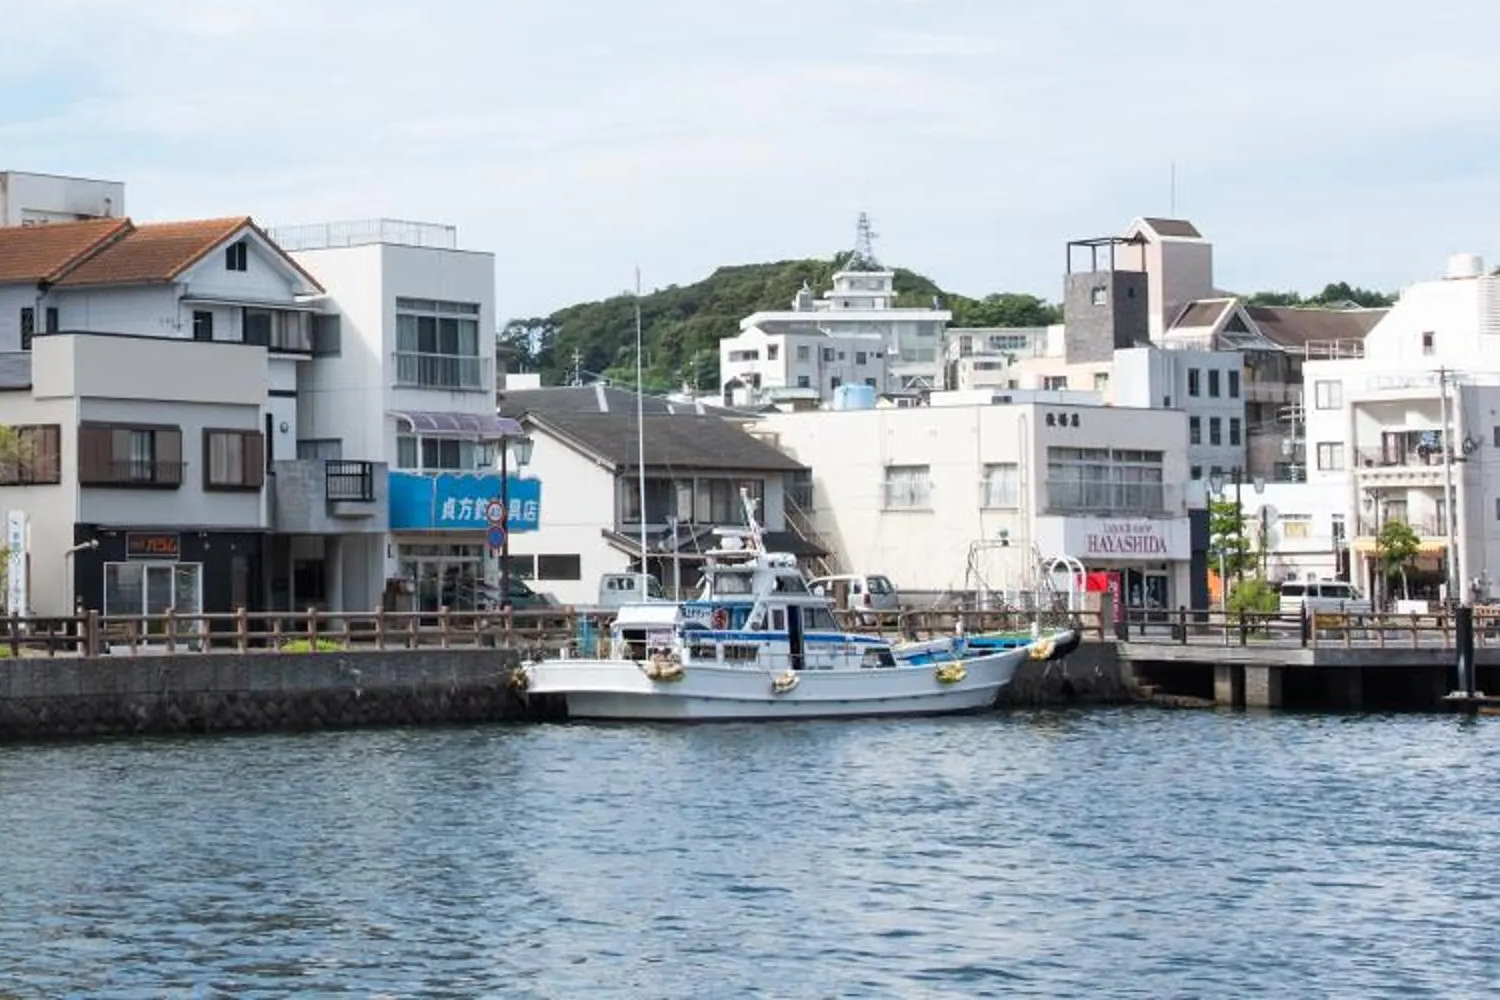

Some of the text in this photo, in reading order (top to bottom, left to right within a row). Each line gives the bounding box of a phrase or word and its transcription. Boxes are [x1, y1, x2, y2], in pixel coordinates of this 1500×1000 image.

[441, 496, 538, 521] 貞方釣具店
[1086, 534, 1167, 552] HAYASHIDA
